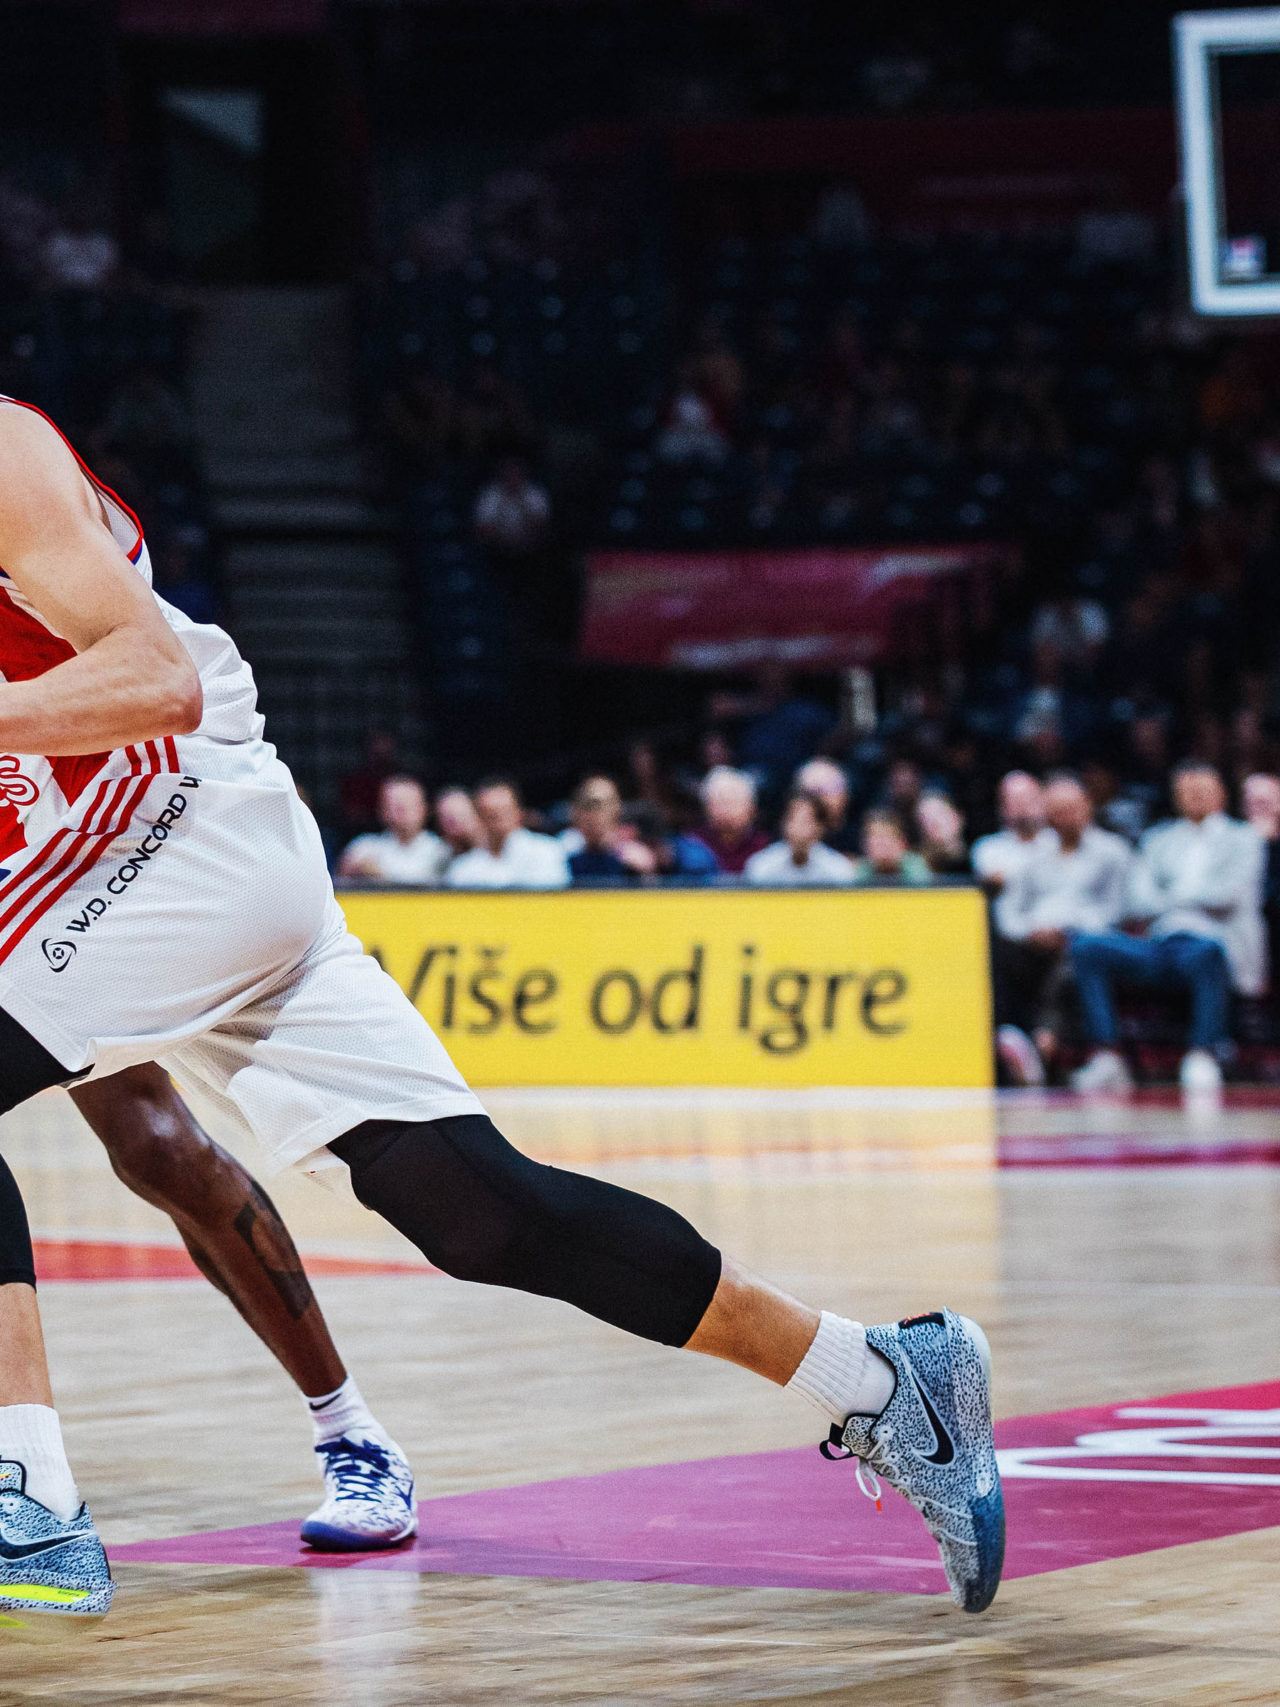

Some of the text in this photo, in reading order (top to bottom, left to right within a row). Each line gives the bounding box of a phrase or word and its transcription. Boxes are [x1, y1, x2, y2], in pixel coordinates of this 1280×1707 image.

[66, 897, 113, 933] W.D.
[106, 793, 188, 895] CONCORD
[588, 941, 707, 1036] od
[736, 943, 911, 1056] igre
